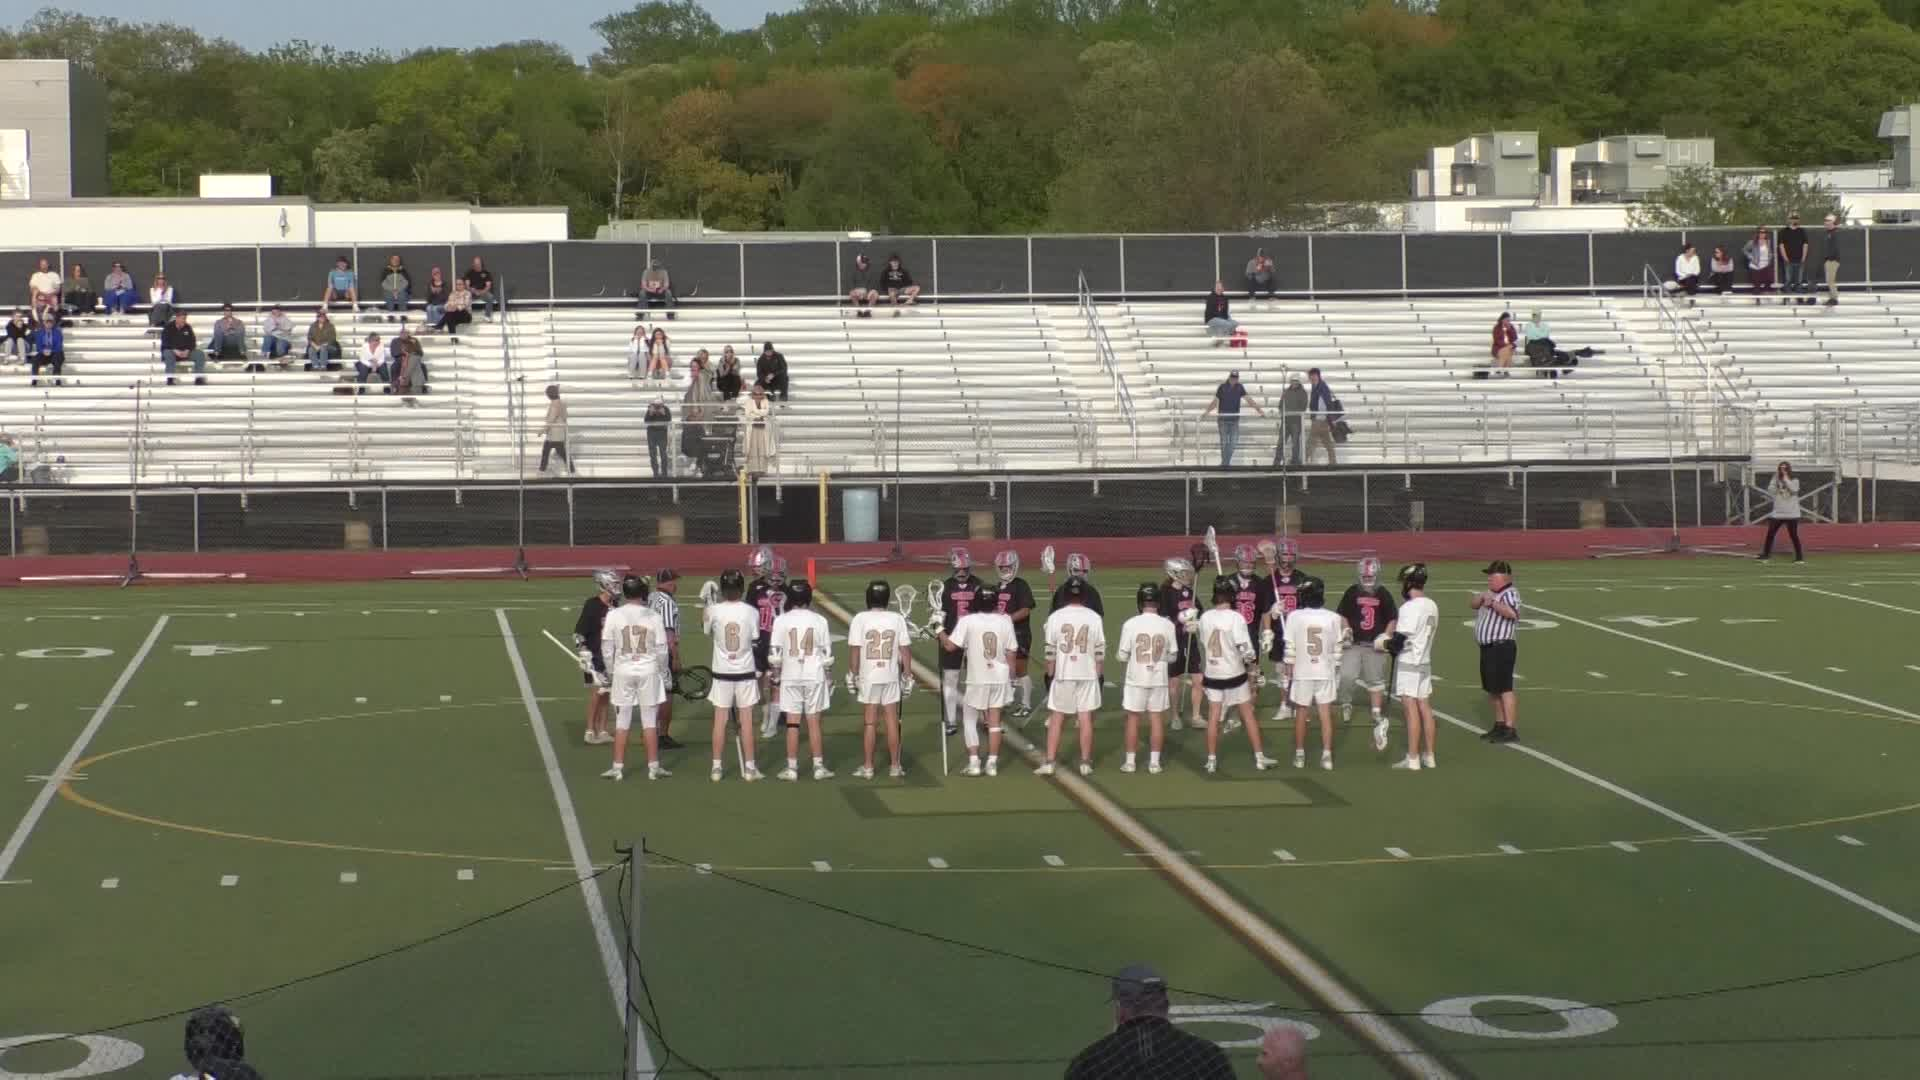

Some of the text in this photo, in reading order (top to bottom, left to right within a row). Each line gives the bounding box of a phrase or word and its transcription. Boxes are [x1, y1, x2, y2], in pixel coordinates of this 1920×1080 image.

[1360, 606, 1375, 631] 3
[620, 625, 648, 654] 17
[788, 627, 815, 657] 14
[865, 629, 896, 660] 22
[982, 631, 998, 660] 9
[1059, 623, 1090, 654] 34
[1207, 629, 1223, 657] 4
[1306, 626, 1323, 656] 5
